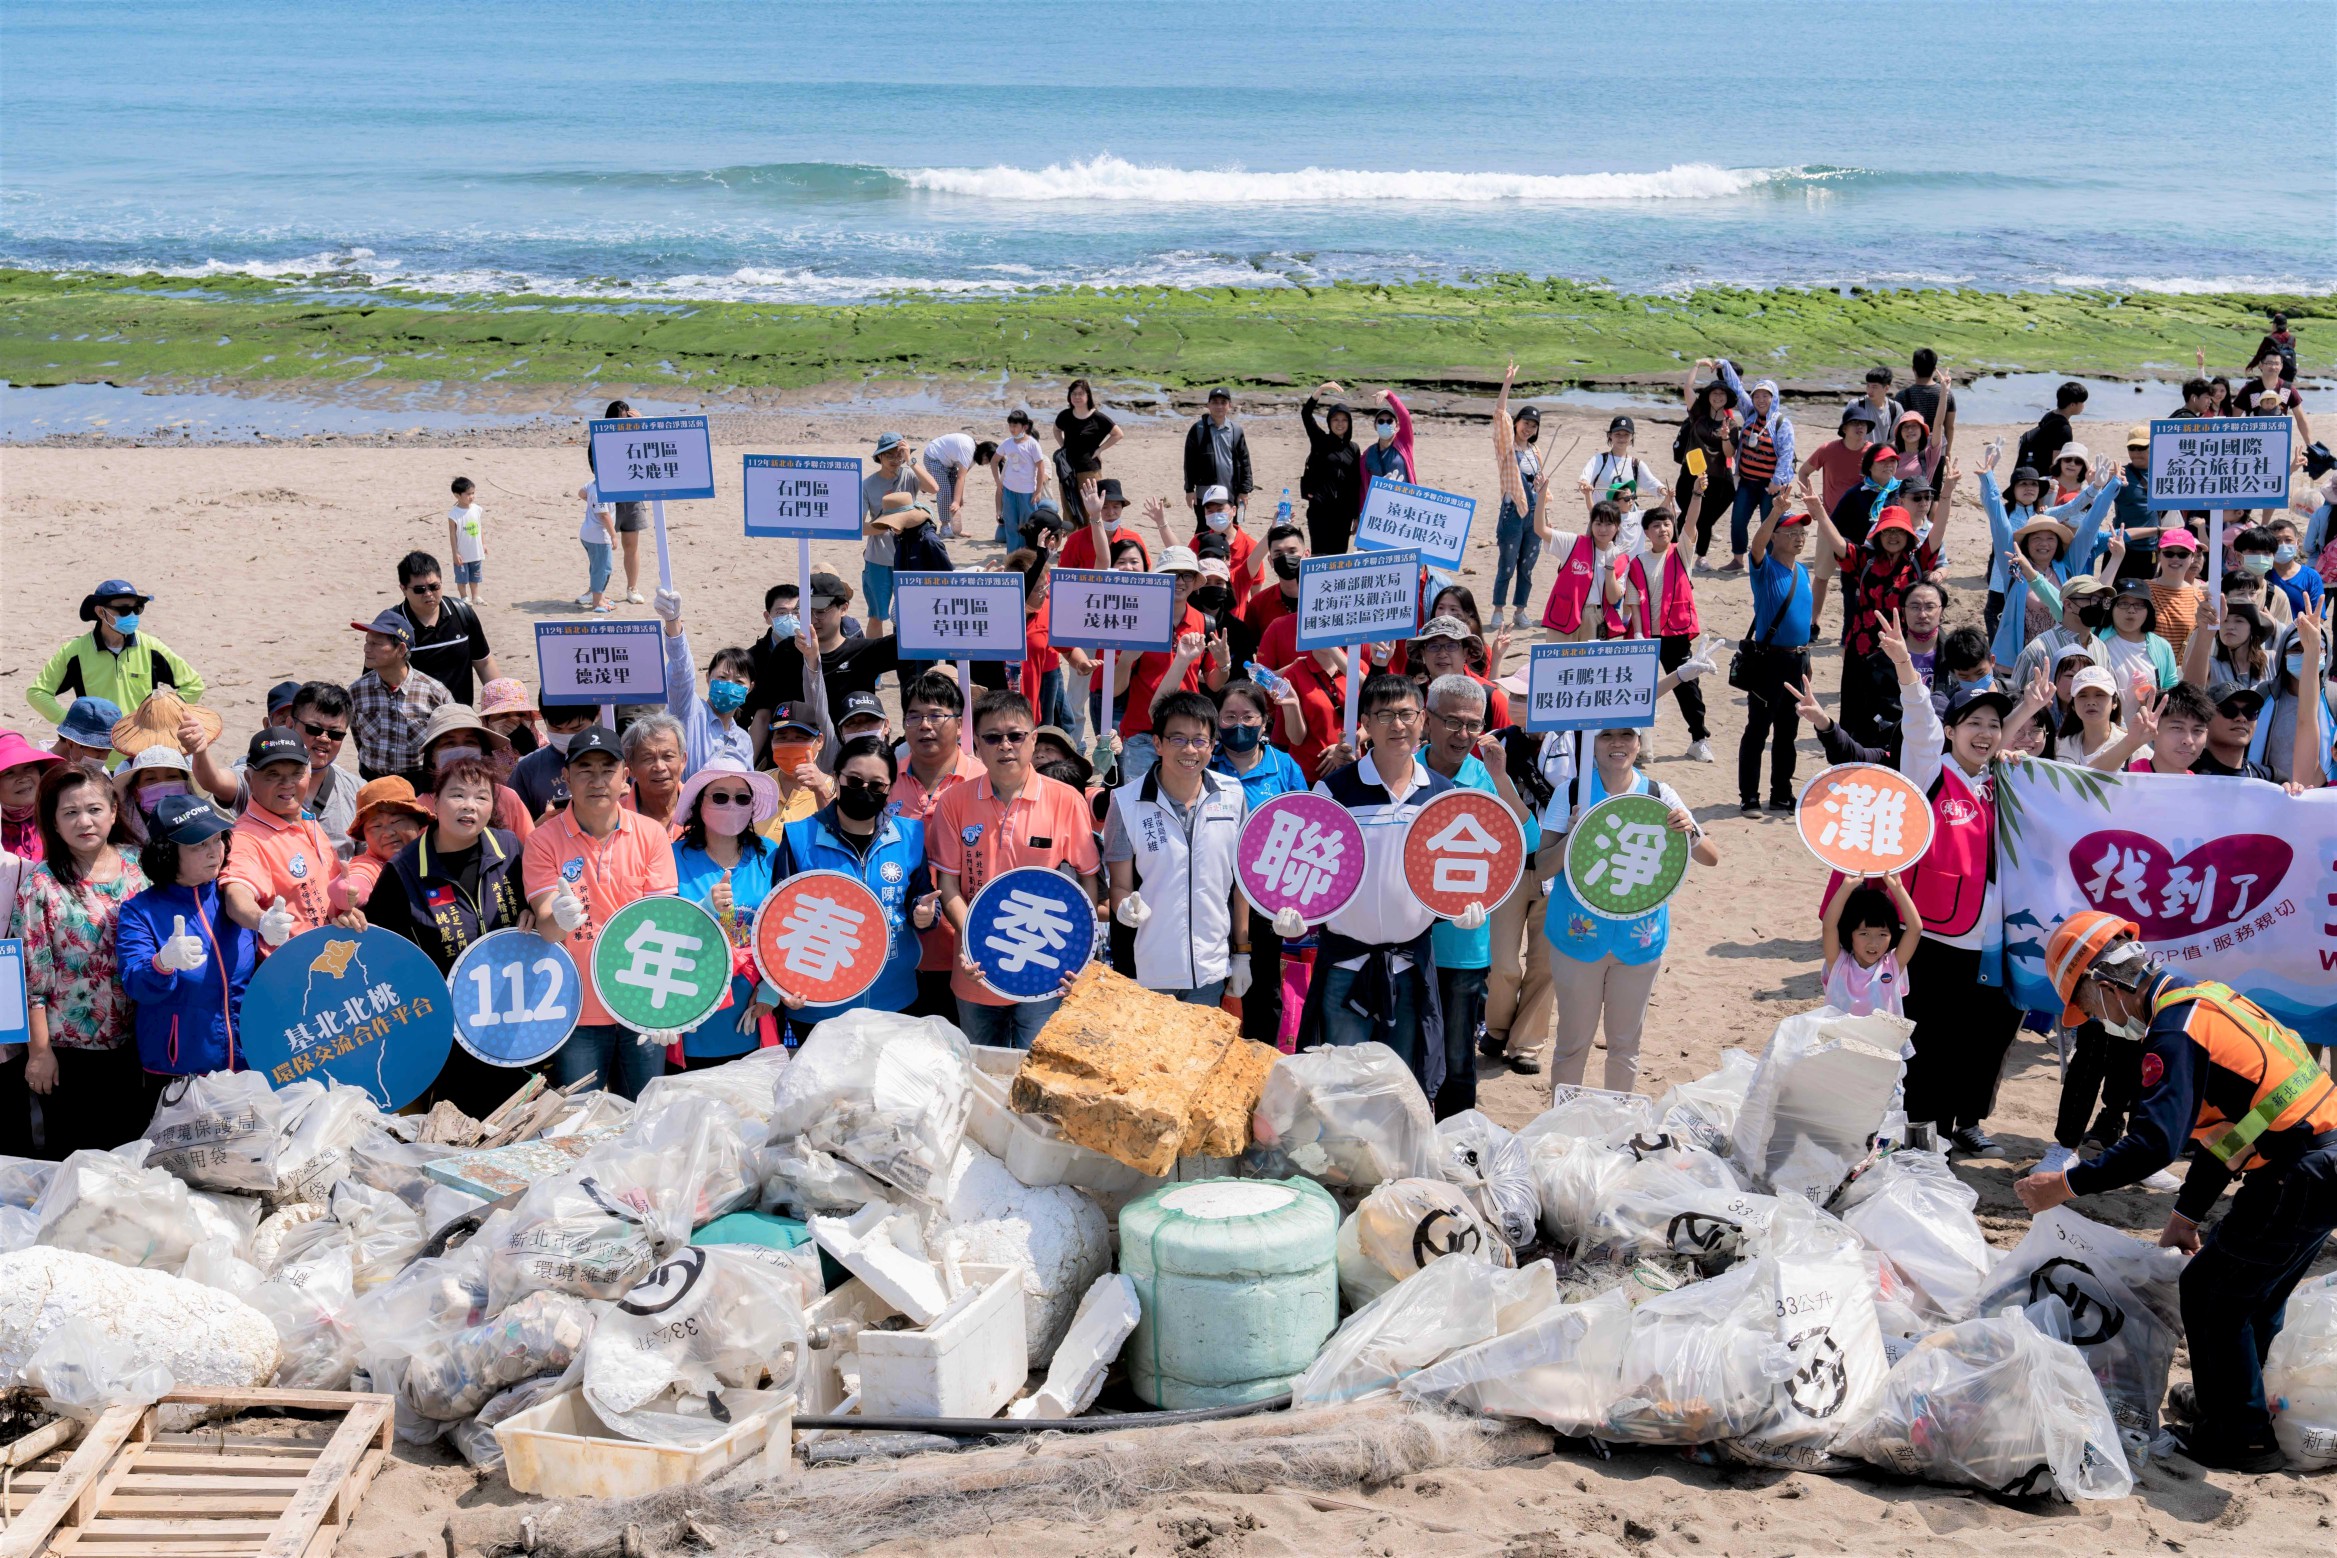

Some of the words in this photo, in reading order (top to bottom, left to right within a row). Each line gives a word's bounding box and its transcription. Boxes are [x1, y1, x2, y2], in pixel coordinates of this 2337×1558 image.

[2156, 422, 2287, 434] 112年新北市春季聯合淨灘活動
[625, 440, 678, 460] 石門區
[2179, 438, 2263, 457] 雙向國際
[628, 461, 679, 480] 尖鹿里
[2167, 457, 2272, 477] 綜合旅行社
[777, 480, 829, 498] 石門區
[2155, 475, 2282, 495] 股份有限公司
[777, 500, 829, 518] 石門里
[1386, 502, 1447, 529] 遠東百貨
[1367, 515, 1458, 550] 股份有限公司
[1320, 573, 1401, 594] 交通部觀光局
[932, 598, 989, 616] 石門區
[1085, 593, 1139, 610] 石門區
[1312, 590, 1407, 612] 北海岸及觀音山
[932, 619, 989, 638] 草里里
[1084, 613, 1138, 631] 茂林里
[1304, 606, 1412, 630] 國家風景區管理處
[573, 646, 629, 664] 石門區
[575, 667, 631, 685] 德茂里
[1557, 666, 1633, 686] 重鵬生技
[1536, 688, 1651, 710] 股份有限公司
[1153, 811, 1168, 845] 環保局長
[1818, 781, 1907, 857] 灘
[1142, 817, 1160, 852] 程大維
[1252, 809, 1346, 904] 聯
[1427, 813, 1501, 894] 合
[1584, 812, 1667, 896] 淨
[2084, 842, 2259, 924] 找到了
[776, 893, 866, 982] 春
[985, 889, 1073, 973] 季
[615, 919, 702, 1009] 年
[469, 958, 567, 1026] 112
[284, 982, 401, 1055] 基北北桃
[271, 998, 434, 1085] 環保交流合作平台
[1775, 1290, 1832, 1318] 33公升
